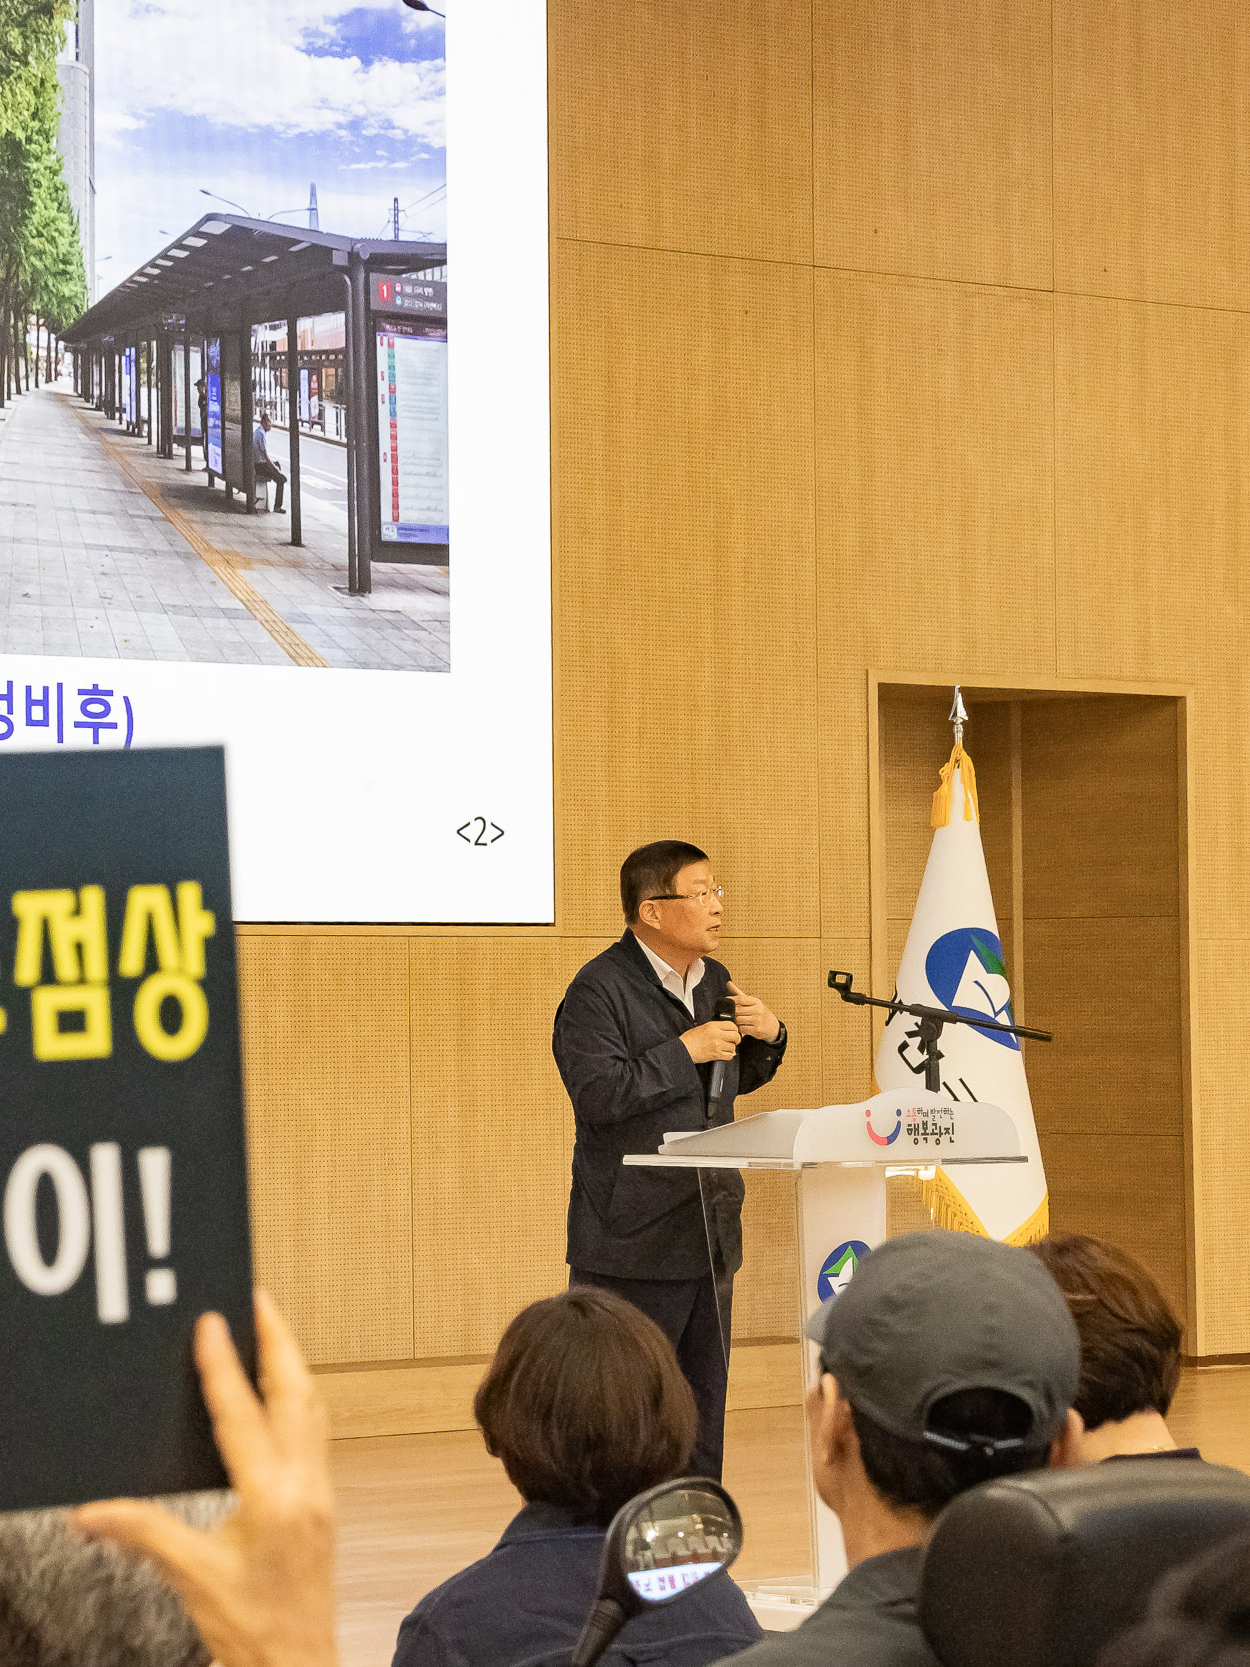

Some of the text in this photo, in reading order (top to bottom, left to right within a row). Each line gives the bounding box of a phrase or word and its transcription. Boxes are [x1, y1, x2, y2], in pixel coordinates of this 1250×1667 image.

[906, 1107, 954, 1122] 소통하며 발전하는
[906, 1120, 955, 1146] 행복광진
